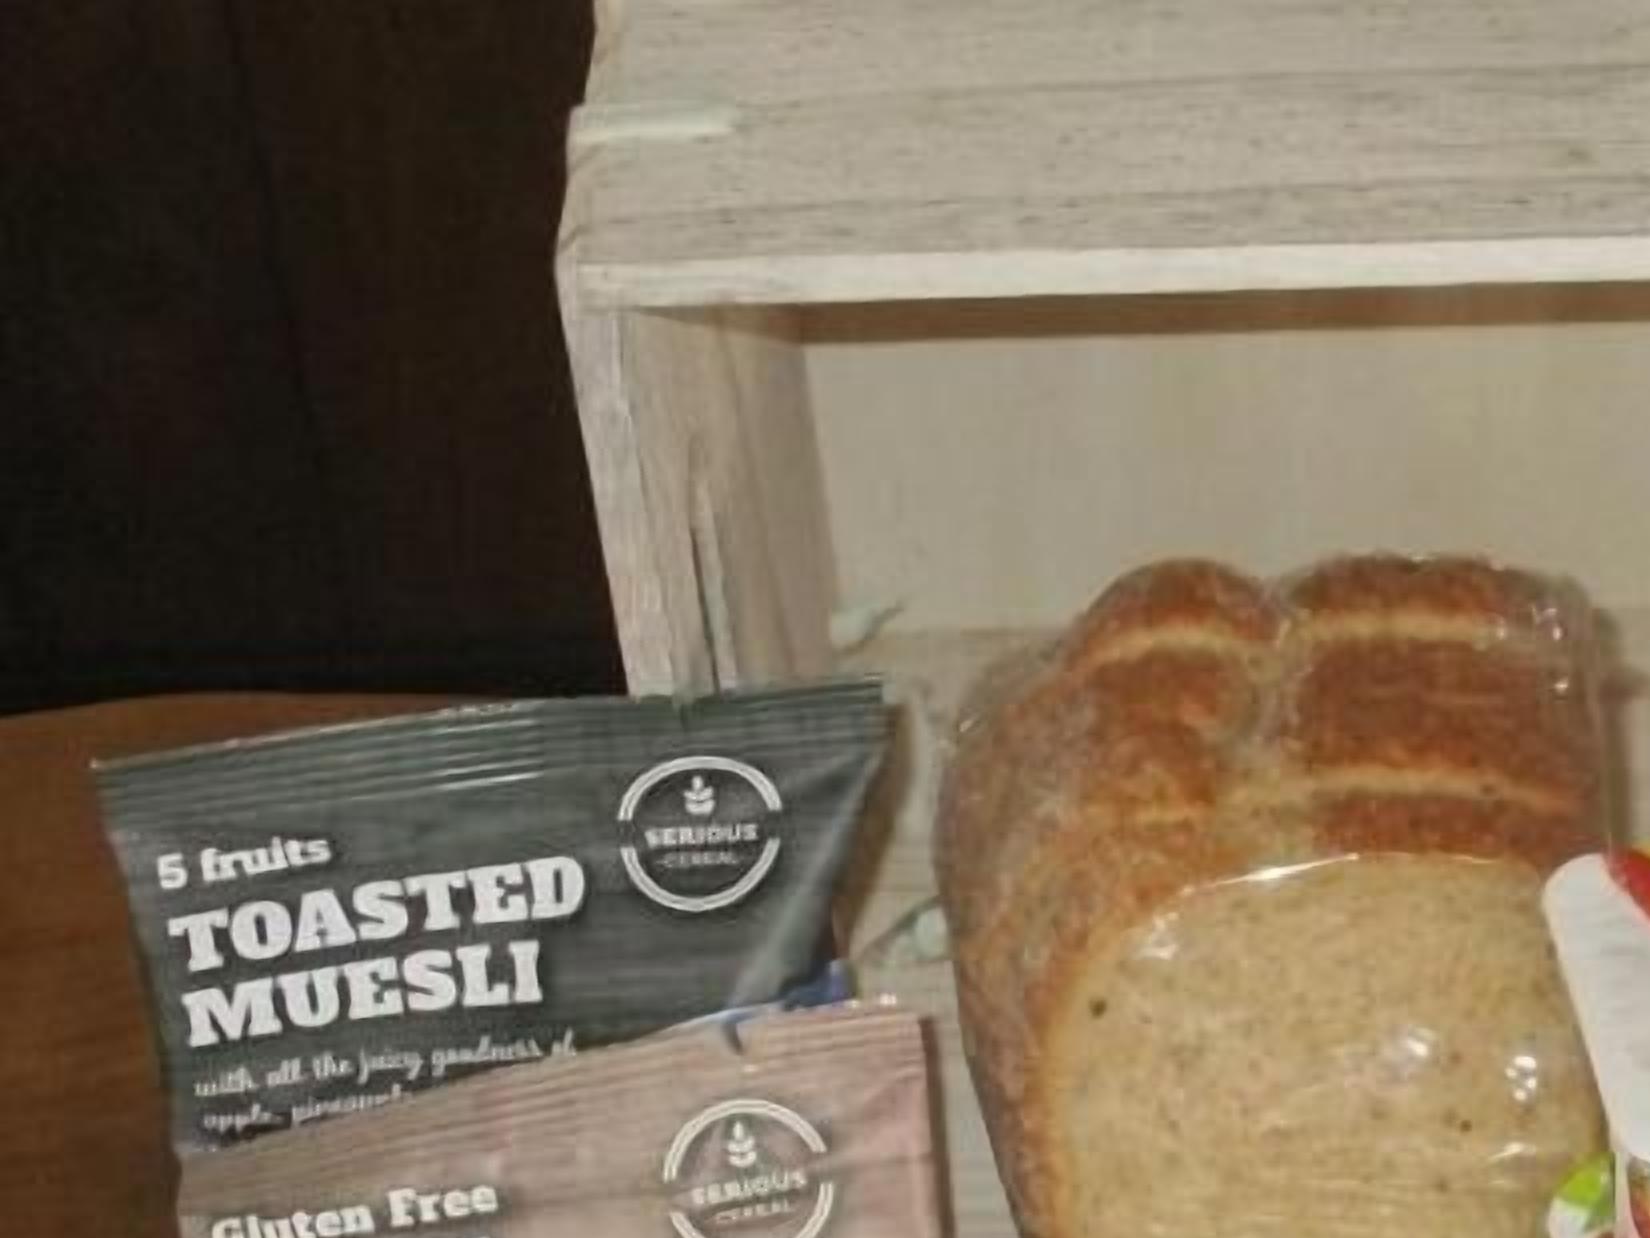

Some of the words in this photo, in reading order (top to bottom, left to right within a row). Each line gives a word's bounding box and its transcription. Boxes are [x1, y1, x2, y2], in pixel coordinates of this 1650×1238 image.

[157, 852, 188, 889] 5
[200, 836, 333, 882] fruits
[168, 856, 586, 972] TOASTED
[181, 939, 543, 1048] MUESLI
[194, 1066, 257, 1098] with
[266, 1057, 302, 1087] all
[312, 1050, 354, 1081] the
[357, 1046, 423, 1085] juicy
[387, 1185, 499, 1228] Free
